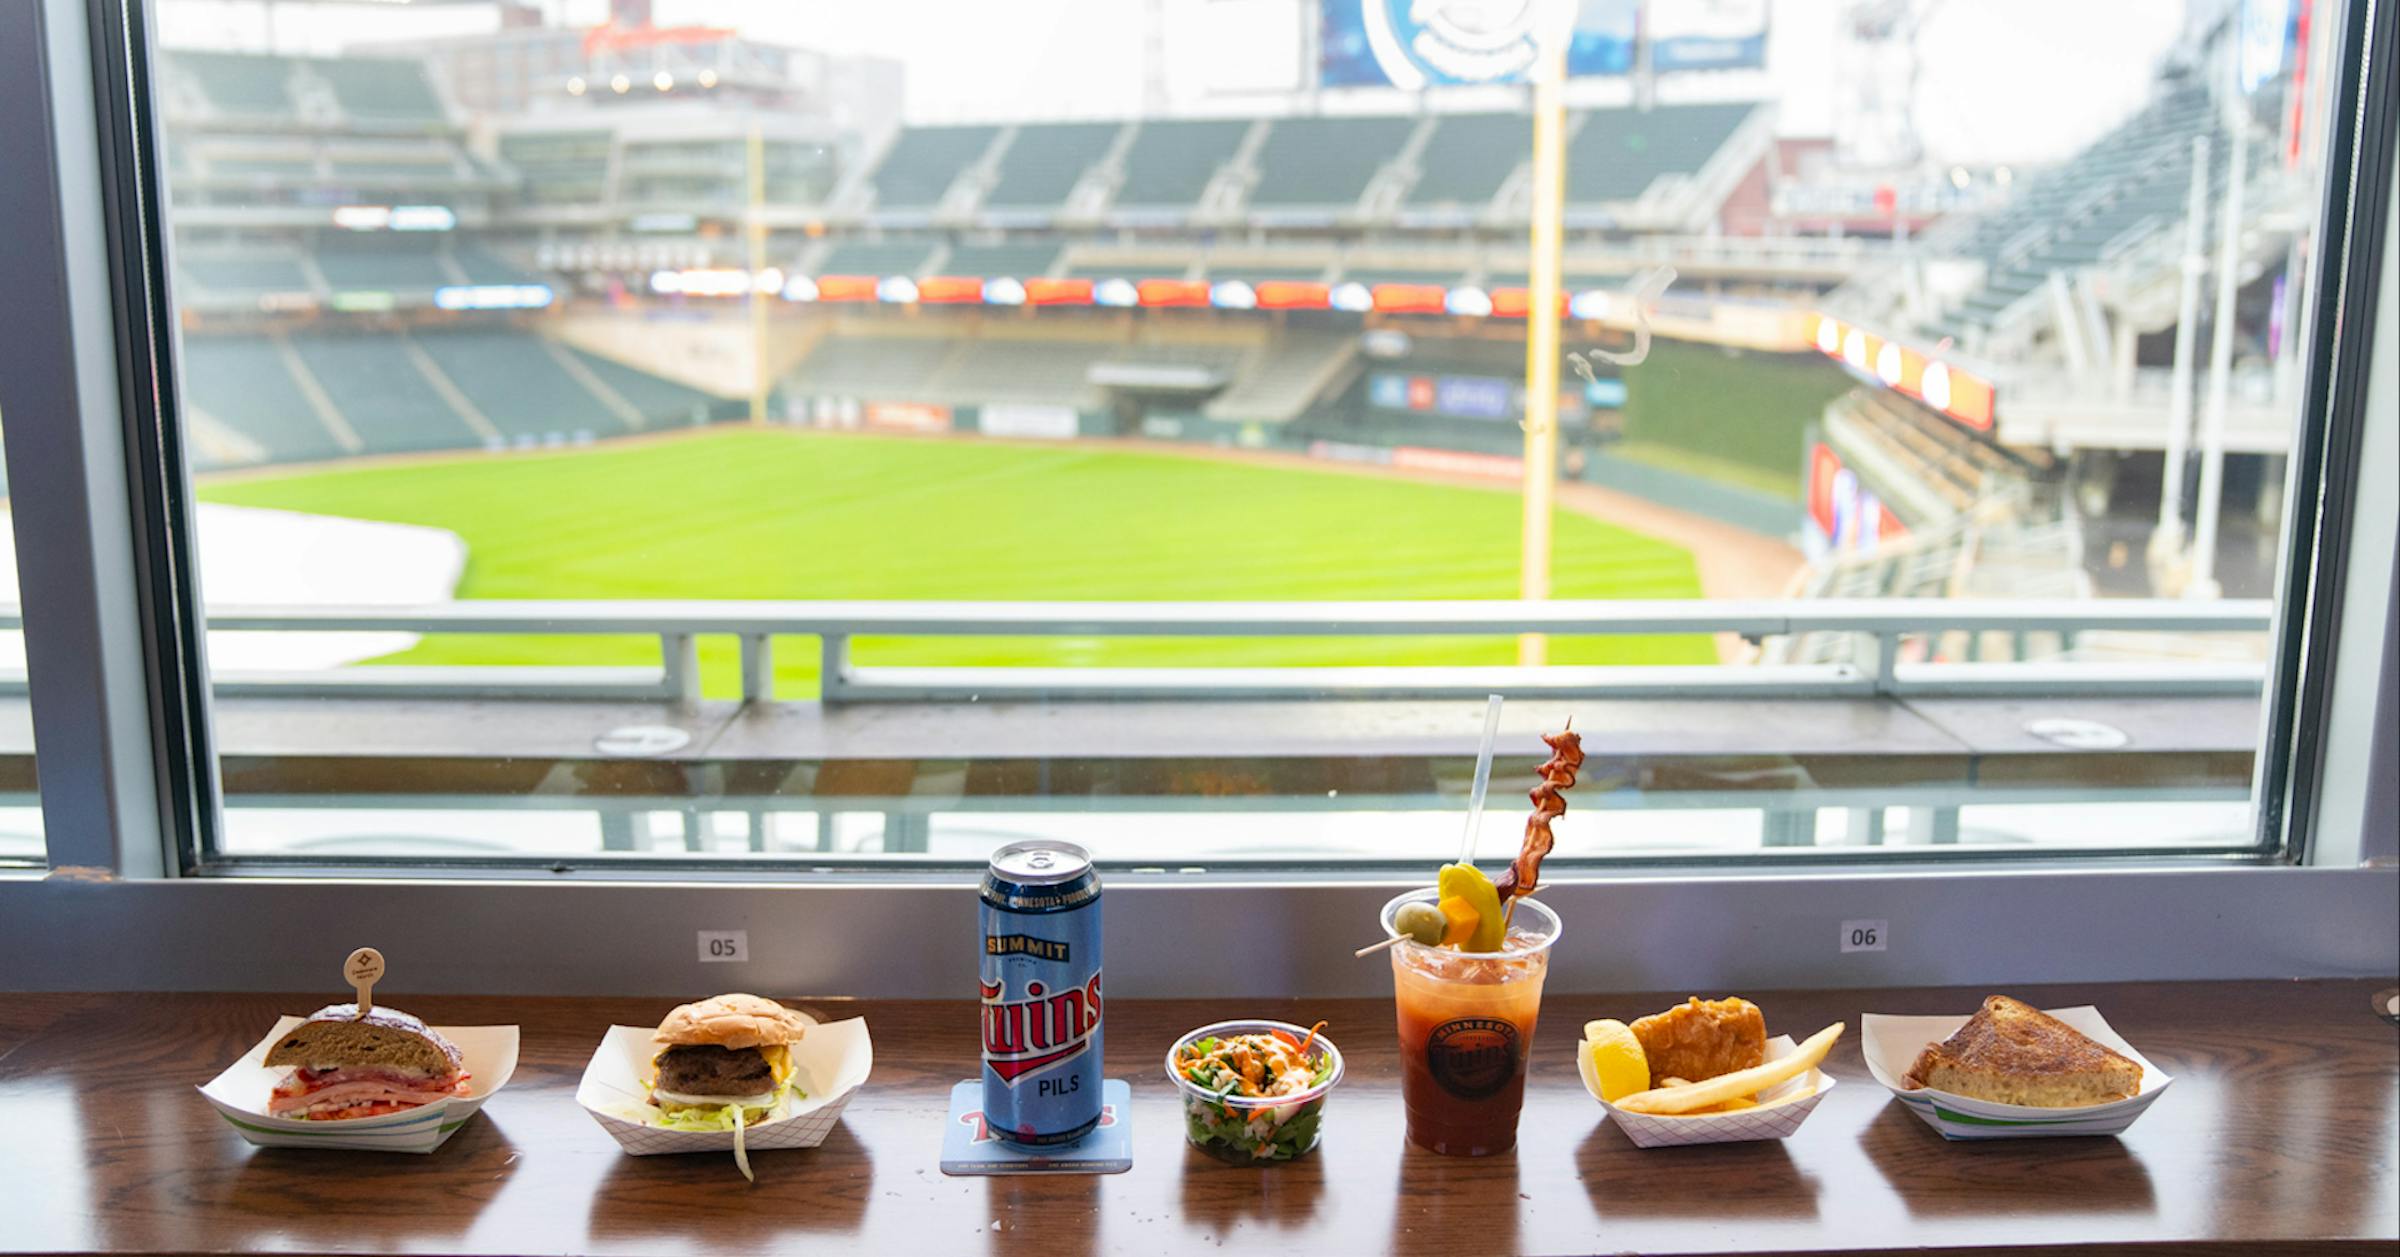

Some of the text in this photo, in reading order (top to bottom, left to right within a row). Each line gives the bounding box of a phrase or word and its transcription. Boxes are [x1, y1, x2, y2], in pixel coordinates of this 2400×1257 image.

[1851, 928, 1876, 946] 06
[710, 939, 736, 956] 05
[987, 936, 1067, 960] SUMMIT
[1039, 1075, 1079, 1096] PILS
